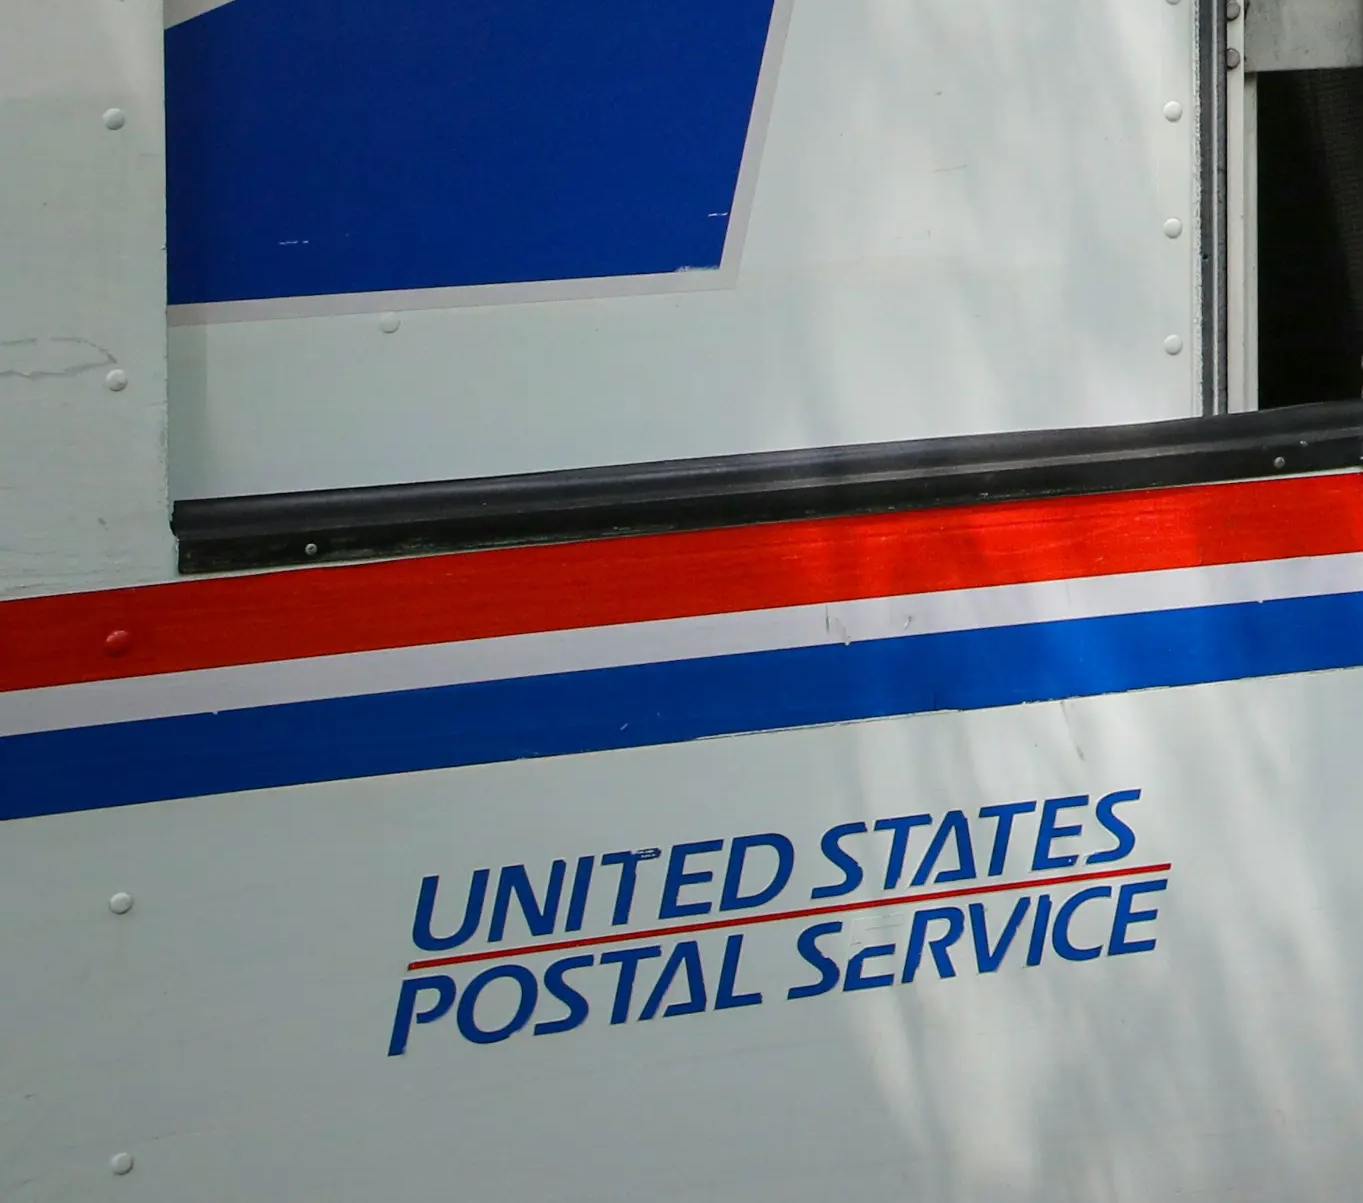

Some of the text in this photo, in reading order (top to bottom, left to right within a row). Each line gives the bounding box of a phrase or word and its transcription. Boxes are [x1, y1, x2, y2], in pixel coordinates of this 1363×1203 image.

[412, 789, 1142, 952] UNITED STATES
[388, 879, 1168, 1057] POSTAL SERVICE
